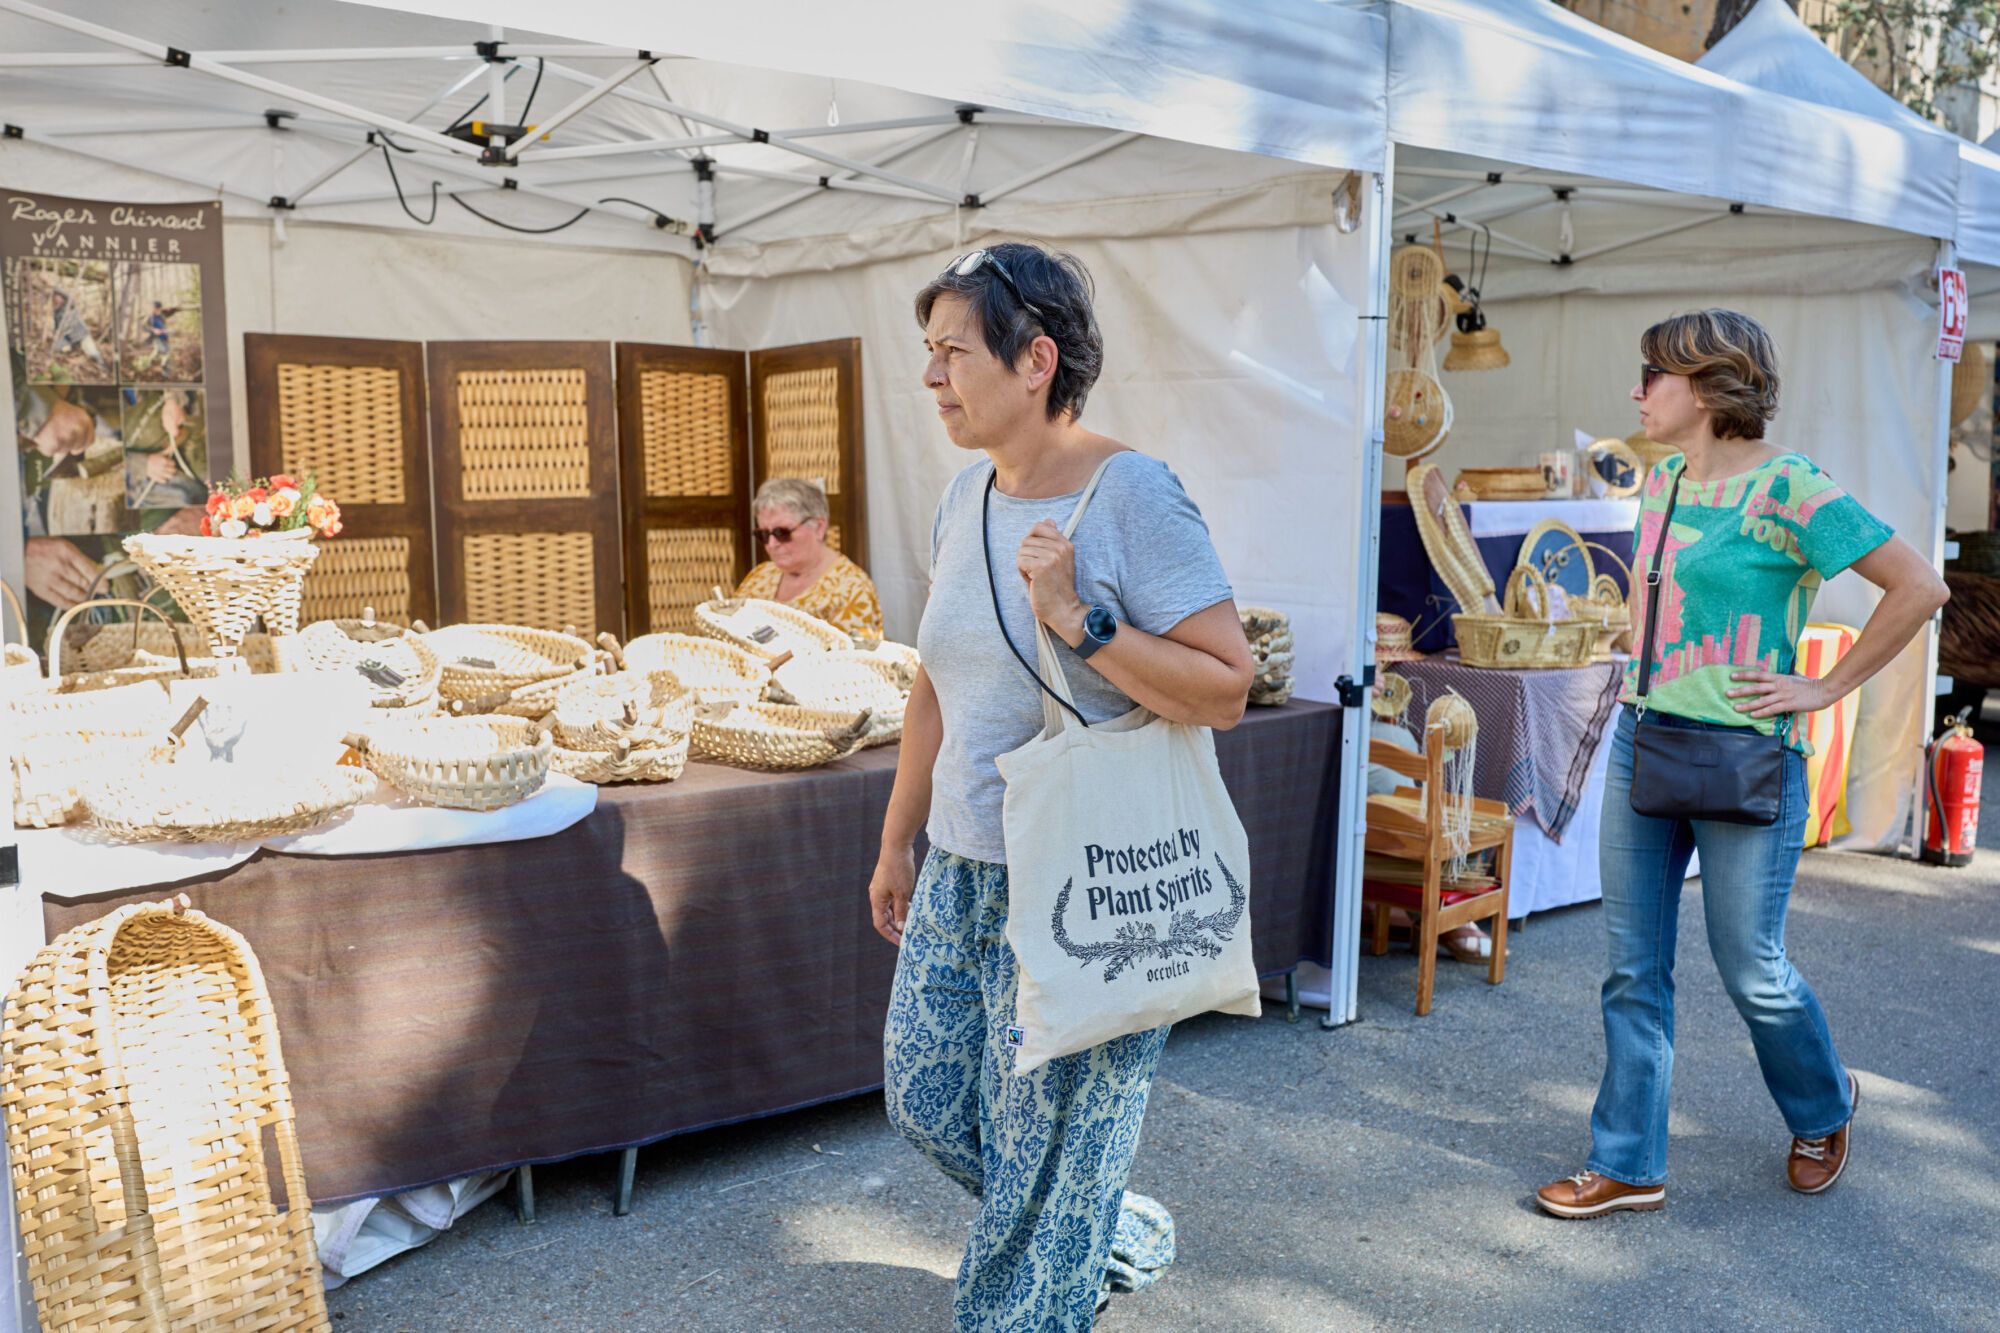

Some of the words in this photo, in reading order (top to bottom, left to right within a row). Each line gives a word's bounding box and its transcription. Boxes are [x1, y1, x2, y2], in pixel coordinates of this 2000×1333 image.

[8, 197, 97, 238] Roger
[110, 206, 206, 230] Chinaud
[32, 233, 180, 253] VANNIER
[33, 247, 64, 257] Bois
[73, 248, 89, 258] de
[1084, 832, 1179, 878] Protected
[1178, 827, 1200, 859] by
[1086, 883, 1153, 920] Plant
[1156, 866, 1213, 912] Spirits
